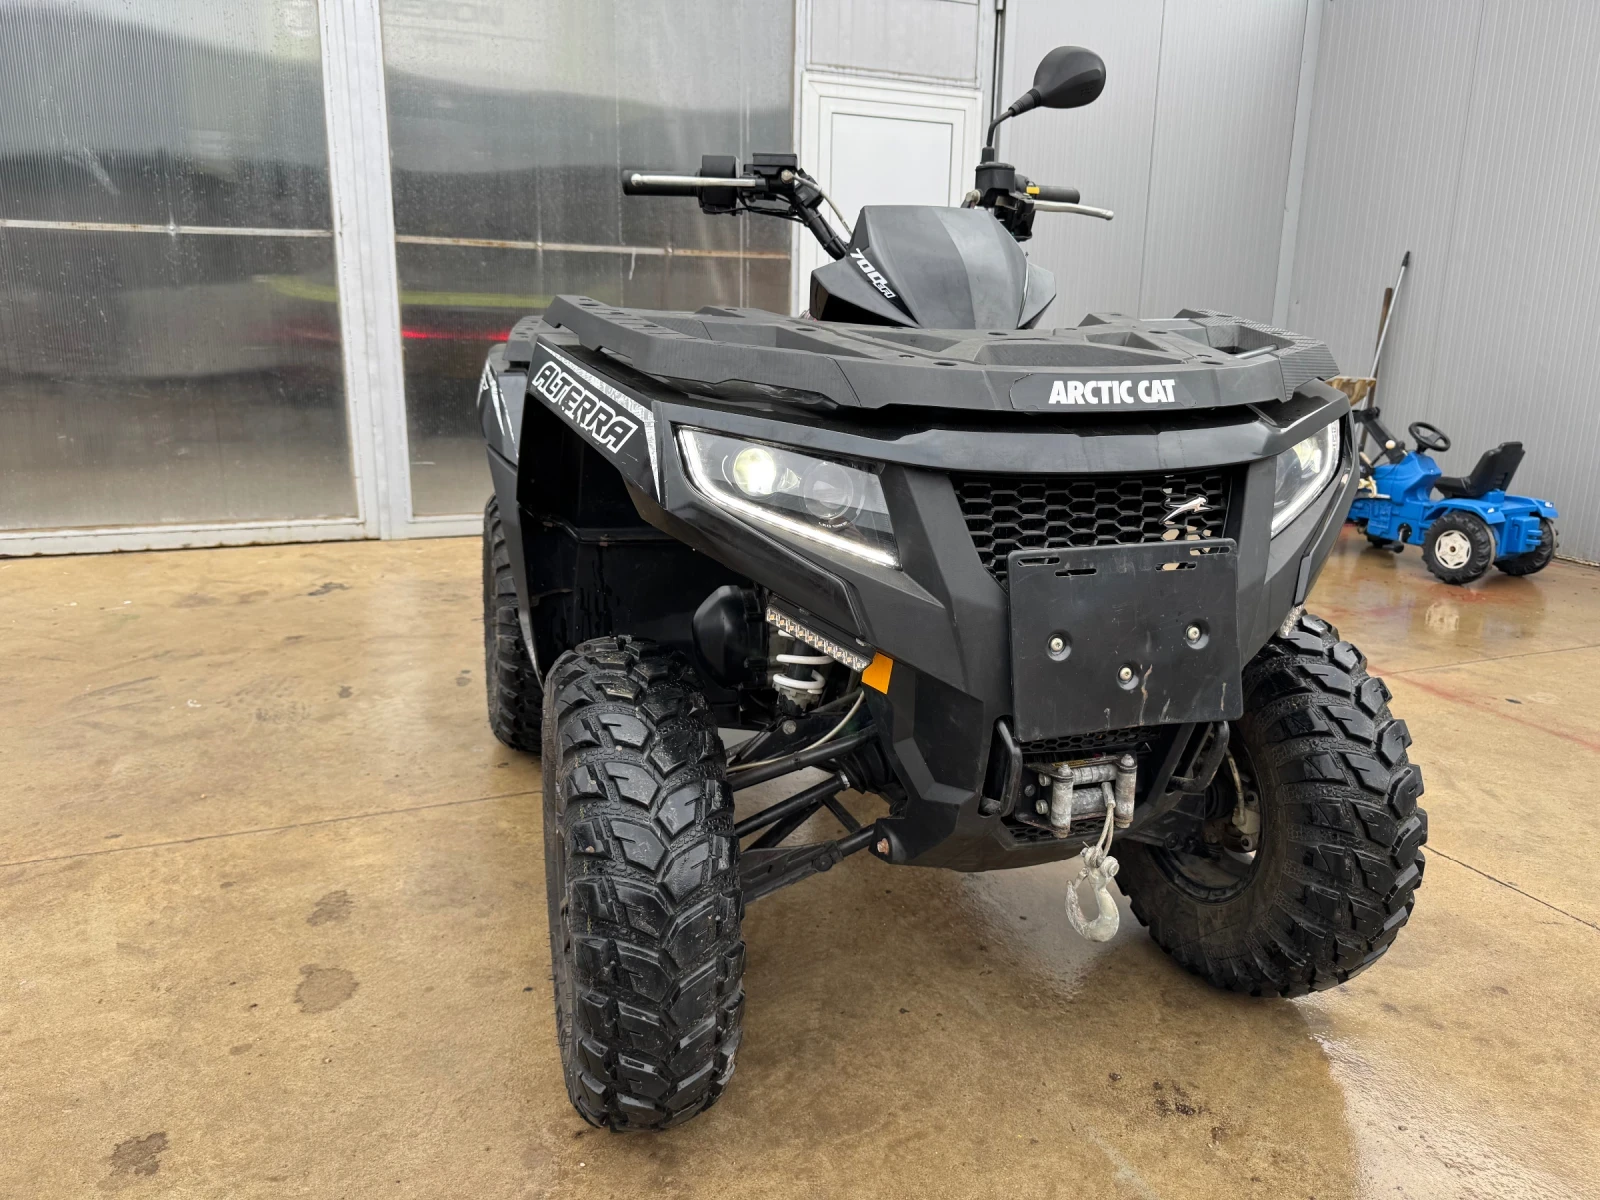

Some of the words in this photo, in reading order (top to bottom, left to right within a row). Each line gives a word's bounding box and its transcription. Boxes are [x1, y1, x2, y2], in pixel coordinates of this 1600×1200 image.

[850, 248, 888, 285] 700
[532, 361, 639, 454] ALTERRA
[1049, 380, 1134, 404] ARCTIC
[1138, 379, 1175, 403] CAT
